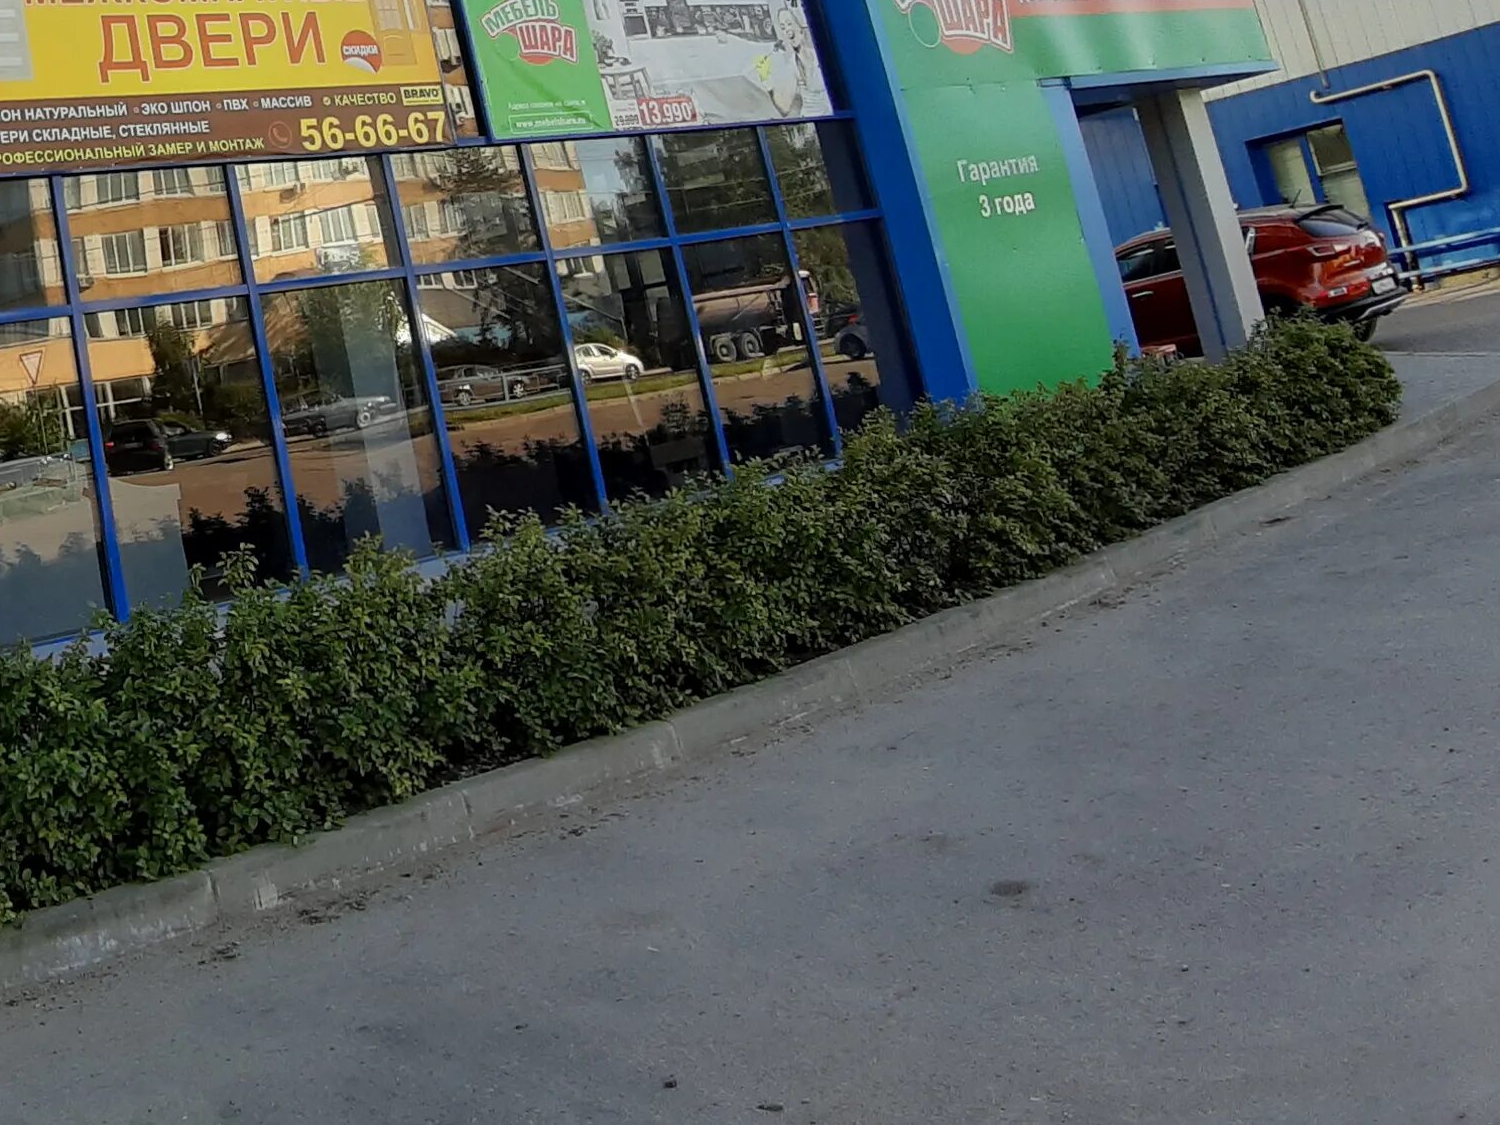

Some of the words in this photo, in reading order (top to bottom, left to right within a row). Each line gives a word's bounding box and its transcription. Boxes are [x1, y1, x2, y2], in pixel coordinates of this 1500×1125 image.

[99, 11, 327, 83] ДВЕРИ
[342, 45, 378, 56] СКИДКИ
[518, 23, 576, 63] ШАРА
[224, 99, 248, 111] ПВХ
[261, 96, 312, 109] МАССИВ
[334, 93, 396, 106] КАЧЕСТВО
[403, 88, 439, 99] BRAVO
[25, 101, 127, 121] НАТУРАЛЬНЫЙ
[141, 104, 168, 115] ЭКО
[171, 101, 211, 113] ШПОН
[32, 126, 116, 143] СКЛАДНЫЕ,
[119, 121, 210, 138] СТЕКЛЯННЫЕ
[300, 111, 446, 152] 56-66-67
[149, 142, 193, 156] ЗАМЕР
[197, 142, 206, 153] И
[210, 138, 265, 152] МОНТАЖ
[956, 154, 1039, 184] Гарантия
[979, 195, 992, 219] 3
[995, 190, 1036, 215] года
